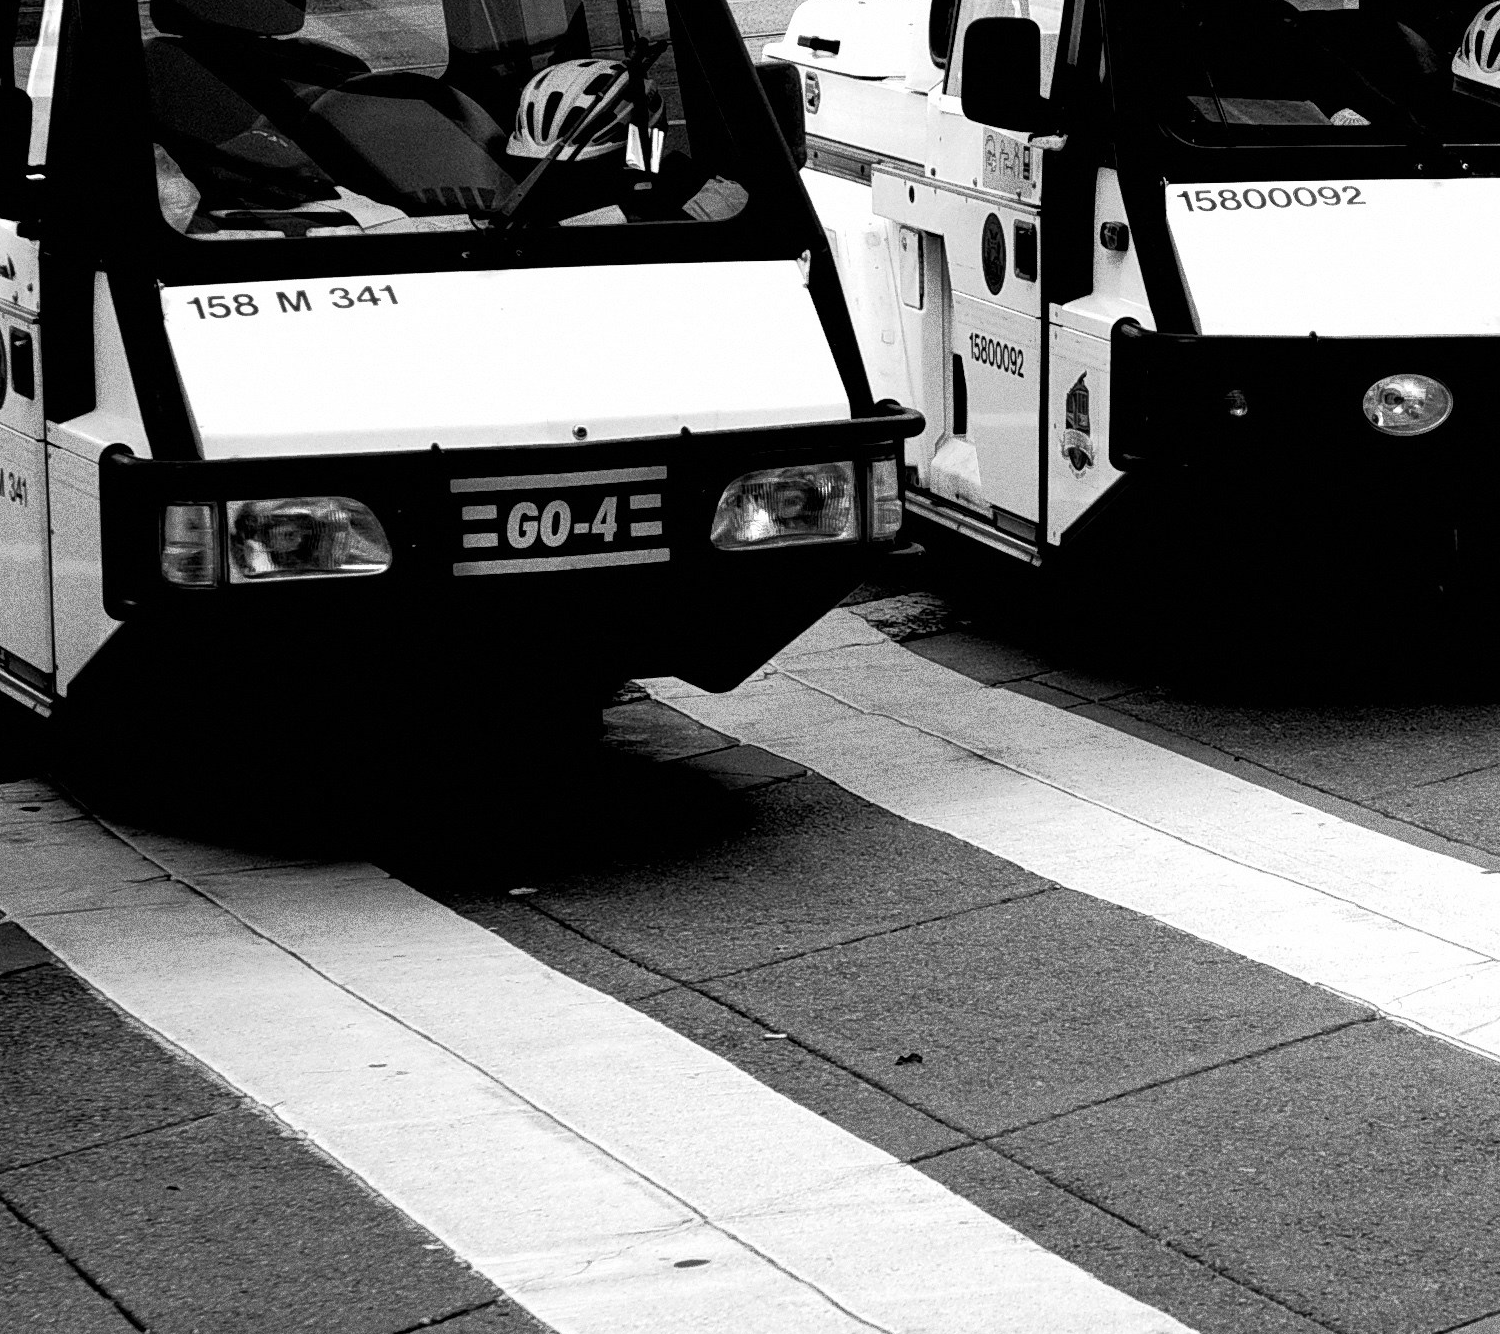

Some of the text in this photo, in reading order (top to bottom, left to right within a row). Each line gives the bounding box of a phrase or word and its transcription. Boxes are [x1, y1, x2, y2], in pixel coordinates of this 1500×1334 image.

[1177, 186, 1367, 212] 15800092
[186, 284, 399, 319] 158 M 341
[969, 332, 1025, 378] 15800092
[8, 471, 28, 508] 341
[506, 495, 618, 549] GO-4
